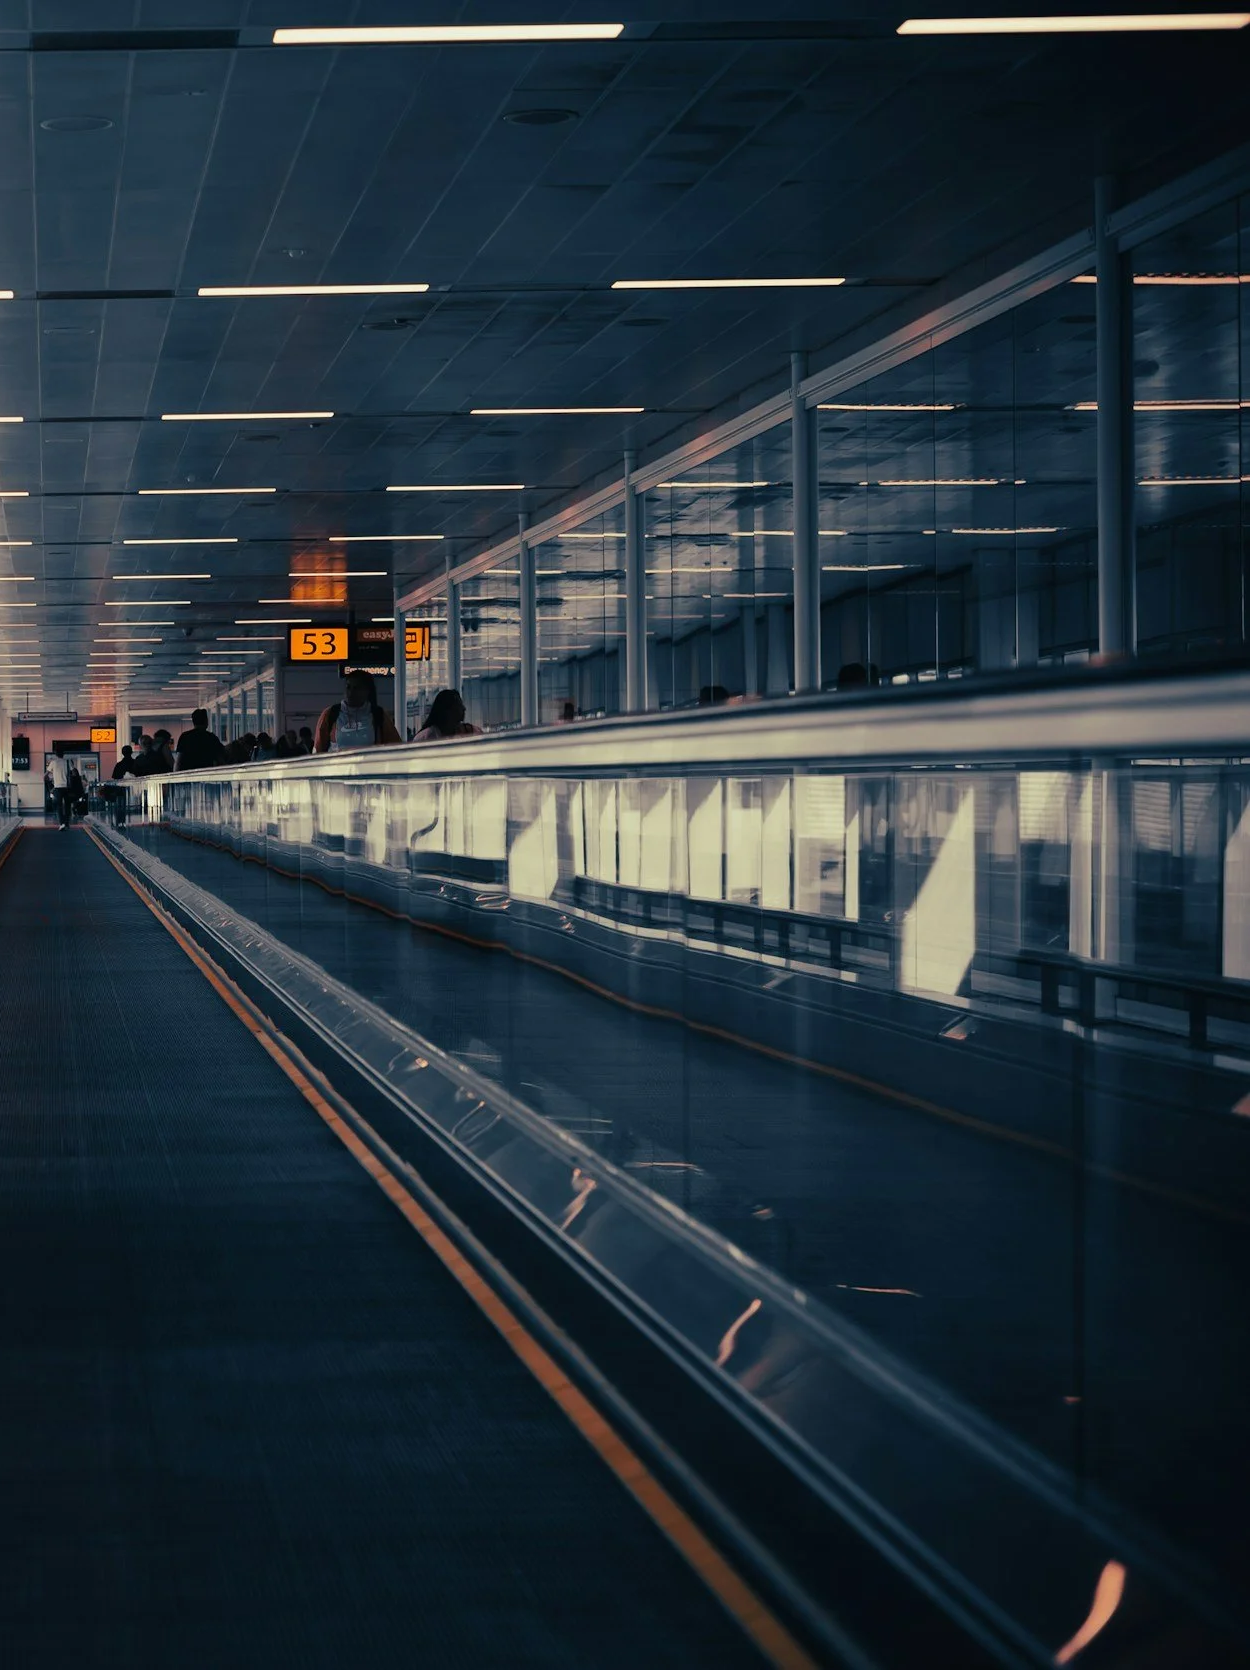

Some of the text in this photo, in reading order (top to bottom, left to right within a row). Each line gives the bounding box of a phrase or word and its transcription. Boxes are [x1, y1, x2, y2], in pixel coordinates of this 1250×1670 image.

[362, 631, 395, 640] easyJ
[302, 633, 336, 655] 53
[96, 731, 110, 741] 52
